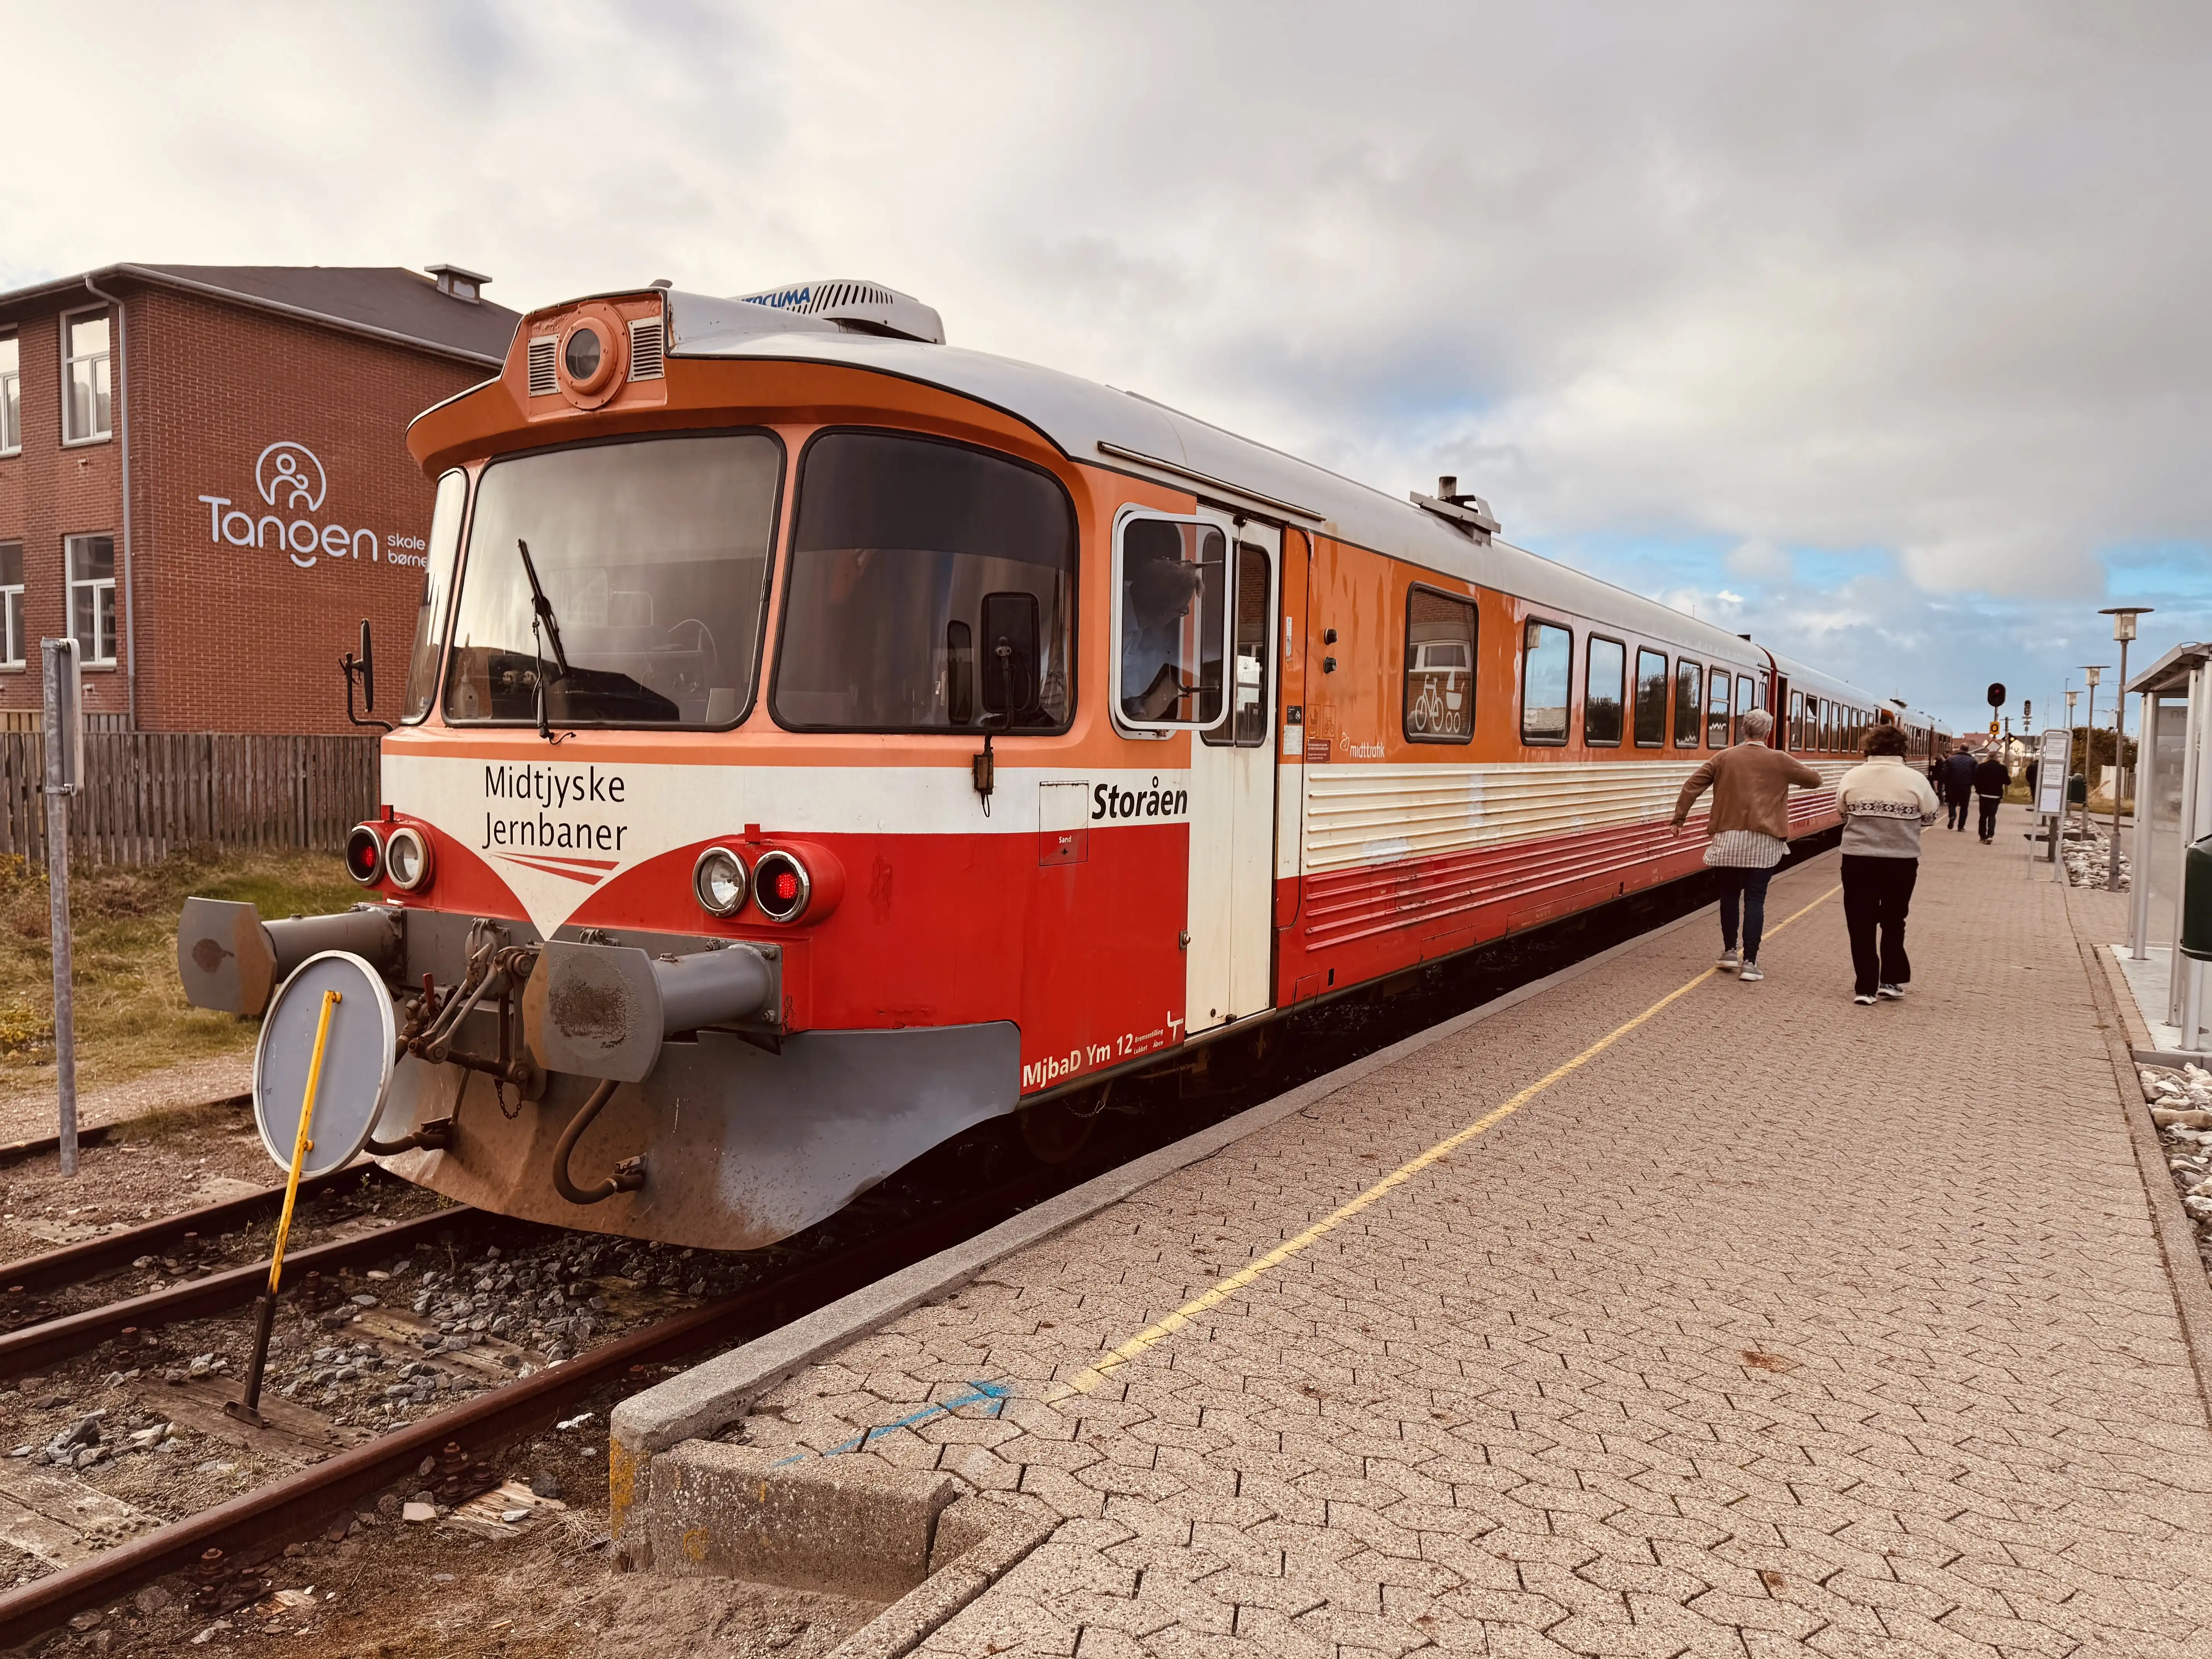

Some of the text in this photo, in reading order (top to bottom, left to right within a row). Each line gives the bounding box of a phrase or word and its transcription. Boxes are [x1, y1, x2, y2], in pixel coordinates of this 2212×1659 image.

[198, 495, 378, 568] Tangen
[387, 533, 426, 550] skole
[1350, 741, 1385, 758] midttrafik
[485, 764, 625, 808] Midtjyske
[1091, 775, 1188, 819] Storåen
[482, 812, 627, 850] Jernbaner
[1058, 835, 1072, 843] Sand
[1133, 1039, 1163, 1054] Lukket Åben
[1135, 1029, 1163, 1043] Bremsestilling
[1023, 1033, 1133, 1088] MjbaD Ym 12
